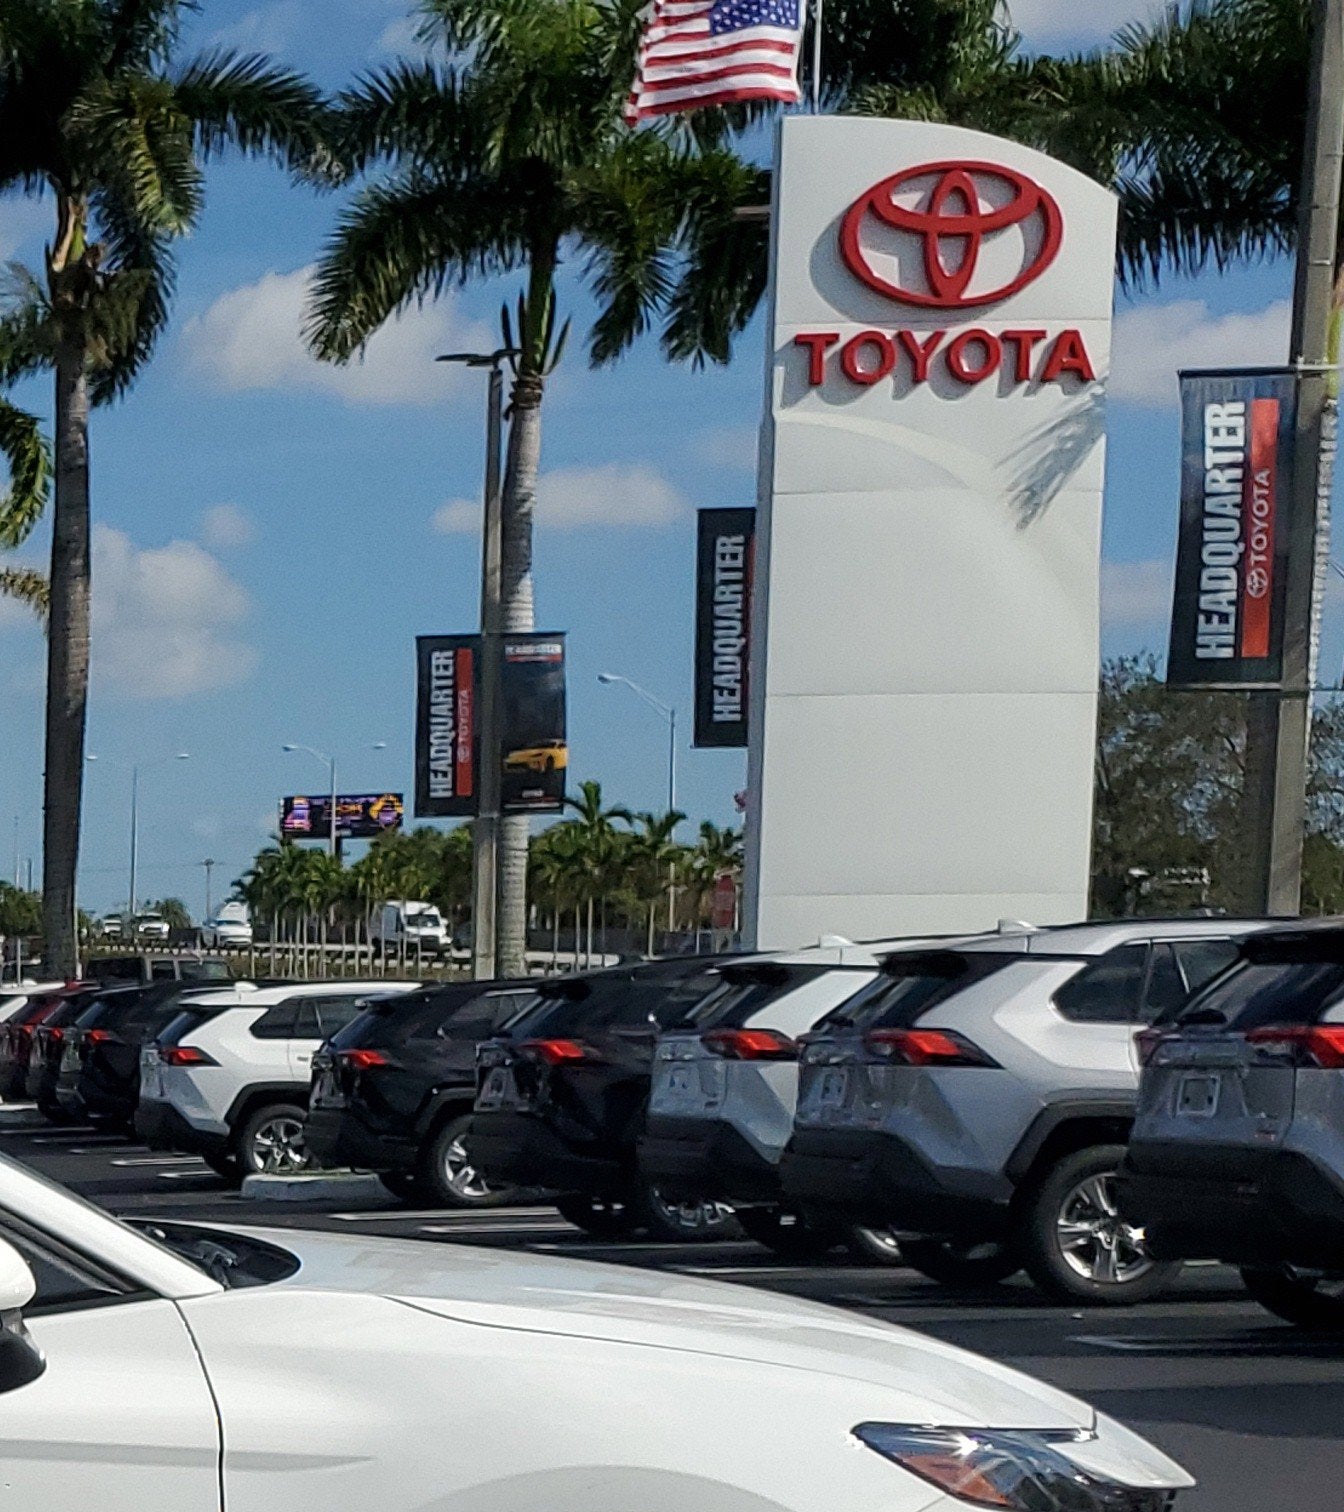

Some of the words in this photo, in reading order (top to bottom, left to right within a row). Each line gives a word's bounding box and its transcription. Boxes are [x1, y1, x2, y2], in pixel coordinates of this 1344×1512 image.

[794, 328, 1096, 385] TOYOTA
[1195, 400, 1246, 659] HEADQUARTER
[1250, 467, 1271, 565] TOYOTA
[713, 535, 746, 723] HEADQUARTER
[430, 650, 455, 798] HEADQUARTER
[458, 689, 469, 743] TOYOTA
